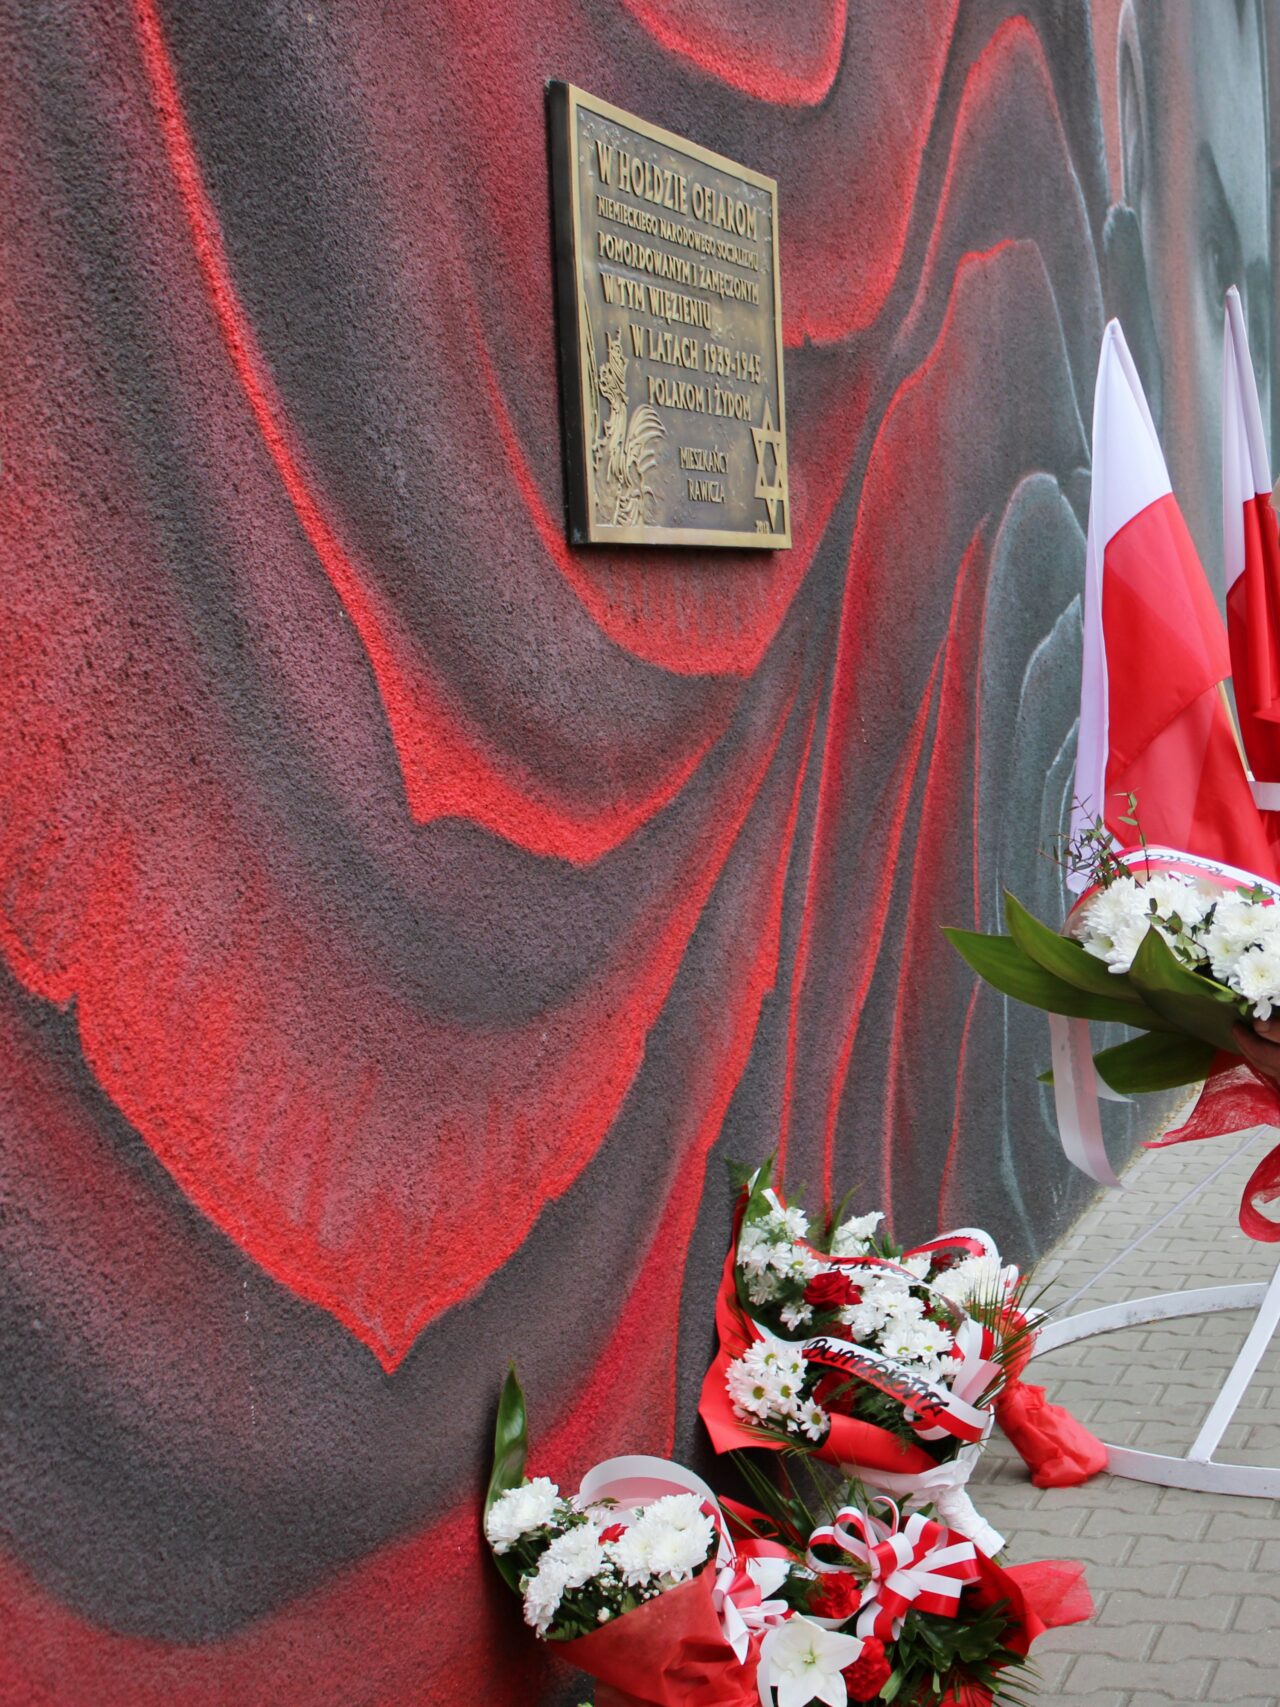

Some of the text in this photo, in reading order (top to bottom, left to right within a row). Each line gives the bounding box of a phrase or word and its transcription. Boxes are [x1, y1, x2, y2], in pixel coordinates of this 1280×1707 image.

[596, 140, 613, 185] W
[692, 182, 758, 242] OFIAROM
[597, 195, 659, 236] NIEMIECKIEGO
[659, 217, 716, 257] NARODOWEGO
[598, 230, 760, 306] POMORDOWANYM I ZAMĘCZONYM
[600, 272, 711, 330] W TYM WIĘZIENIU
[630, 324, 761, 385] W LATACH 1939-1945
[647, 376, 705, 413] POLAKOM
[714, 382, 752, 422] ŻYDOM
[679, 444, 729, 475] MIESZKAŃCY
[687, 478, 726, 504] RAWICZA
